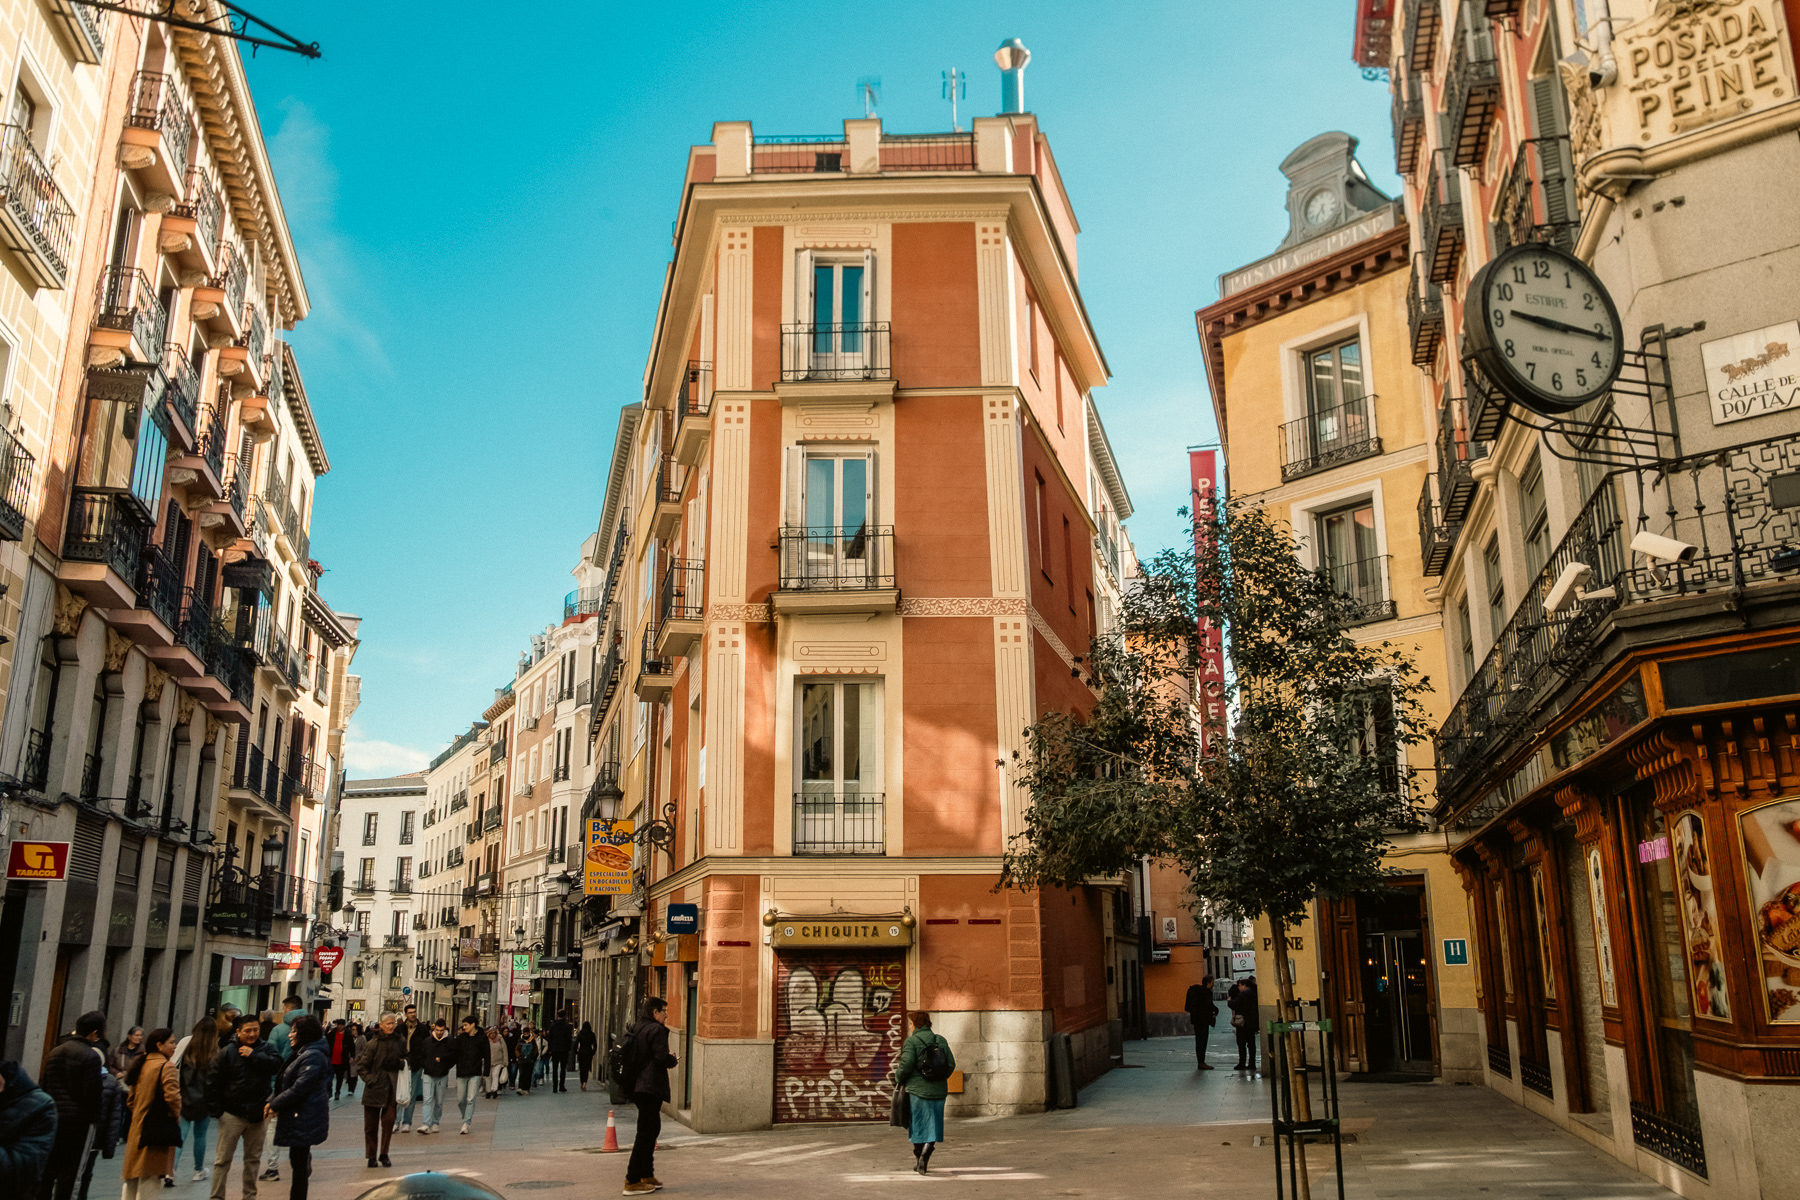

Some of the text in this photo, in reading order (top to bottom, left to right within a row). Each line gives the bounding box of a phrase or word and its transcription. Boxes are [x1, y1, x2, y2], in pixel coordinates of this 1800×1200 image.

[1629, 5, 1767, 79] POSADA
[1678, 55, 1725, 80] DEL
[1636, 51, 1778, 129] PEINE
[1229, 254, 1300, 293] POSADA
[1326, 215, 1385, 253] PEINE
[1513, 266, 1527, 284] 11
[1532, 260, 1551, 279] 12
[1564, 272, 1572, 289] 1
[1496, 282, 1514, 301] 10
[1583, 293, 1594, 311] 2
[1493, 309, 1505, 328] 9
[1504, 339, 1516, 358] 8
[1591, 351, 1602, 369] 4
[1526, 362, 1536, 381] 7
[1576, 368, 1587, 387] 5
[1552, 372, 1563, 391] 6
[1718, 374, 1797, 401] CALLE DE
[592, 821, 611, 832] Ba
[16, 869, 57, 878] TABACOS
[801, 925, 880, 938] CHIQUITA
[1262, 936, 1304, 951] PNE
[1449, 942, 1461, 956] H
